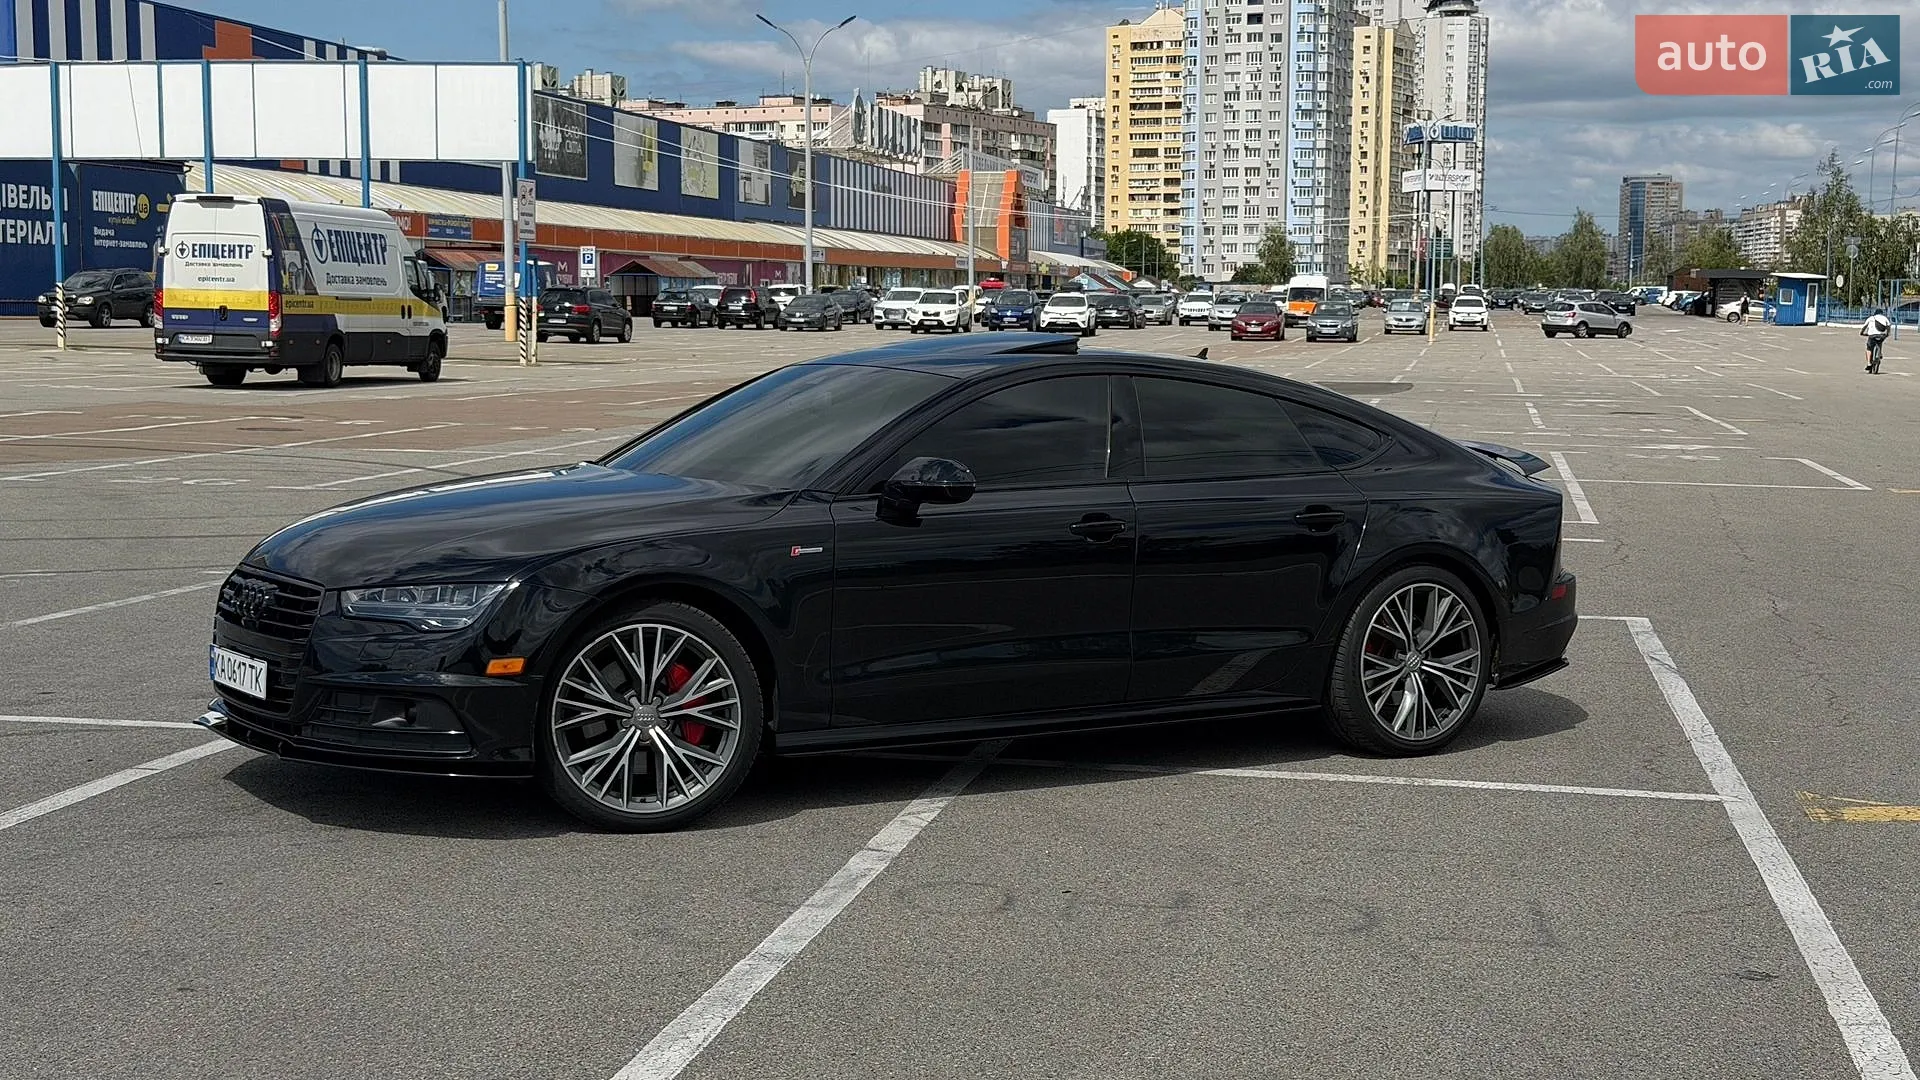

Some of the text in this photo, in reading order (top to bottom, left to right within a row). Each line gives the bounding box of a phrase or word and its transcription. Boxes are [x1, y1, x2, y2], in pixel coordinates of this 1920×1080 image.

[192, 243, 254, 260] ЕПІЦЕНТР
[326, 229, 388, 265] ЕПІЦЕНТР
[584, 253, 592, 264] P
[325, 272, 388, 287] Доставка замовлень
[248, 664, 263, 692] TK
